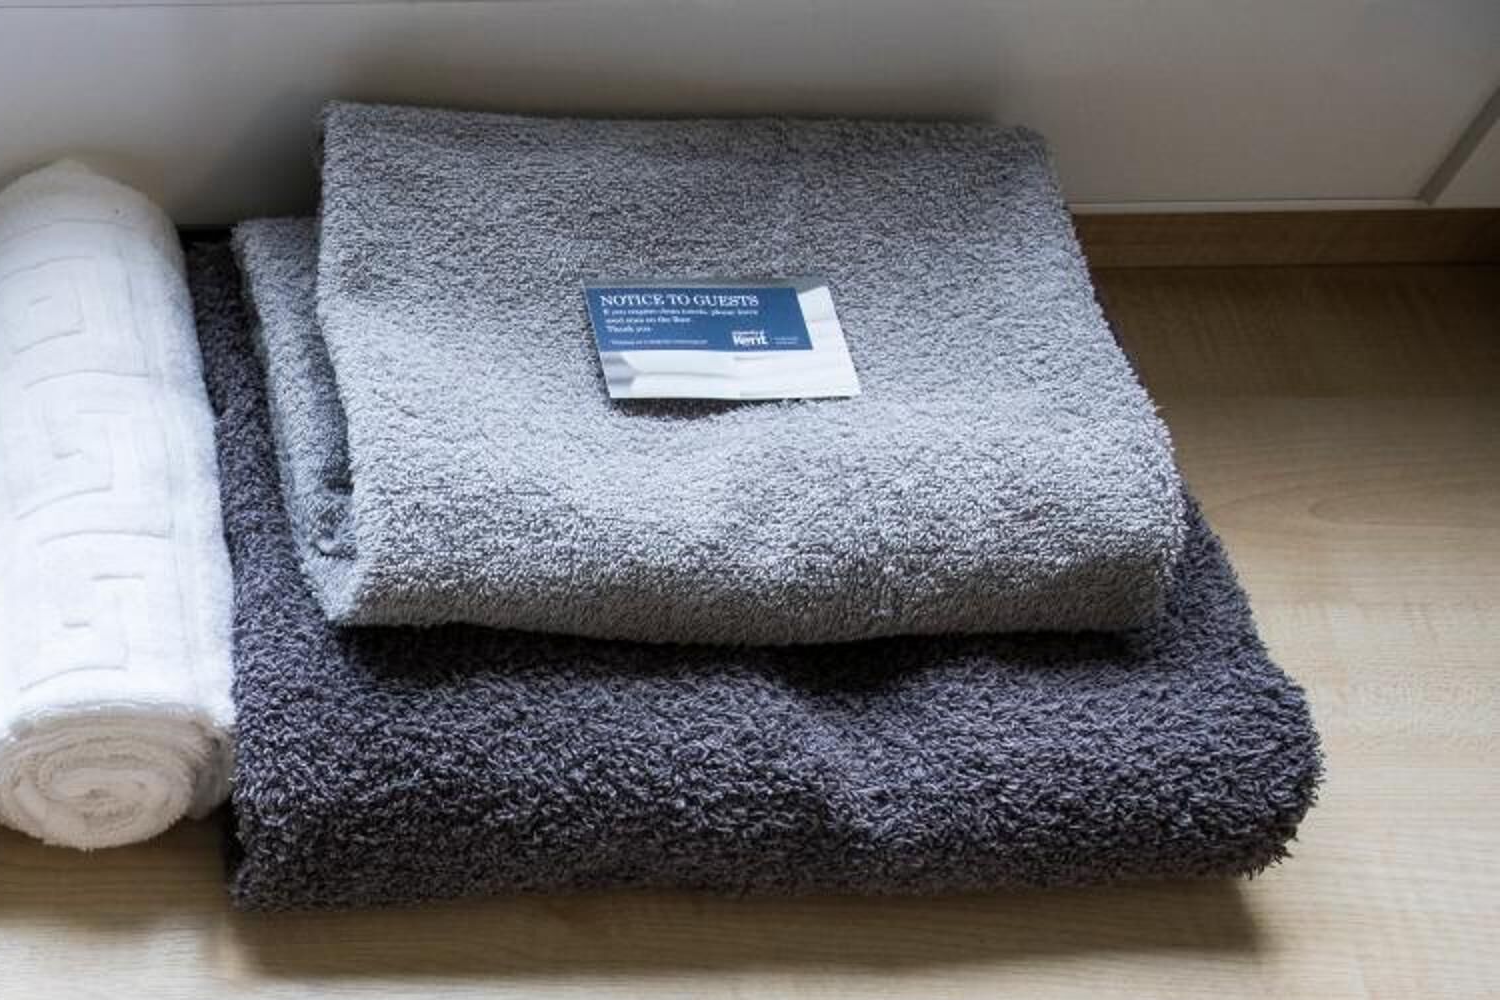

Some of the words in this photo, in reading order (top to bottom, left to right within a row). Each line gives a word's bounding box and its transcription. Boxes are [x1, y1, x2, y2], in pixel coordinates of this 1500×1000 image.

[599, 293, 665, 307] NOTICE
[666, 293, 691, 307] TO
[693, 293, 760, 307] GUESTS
